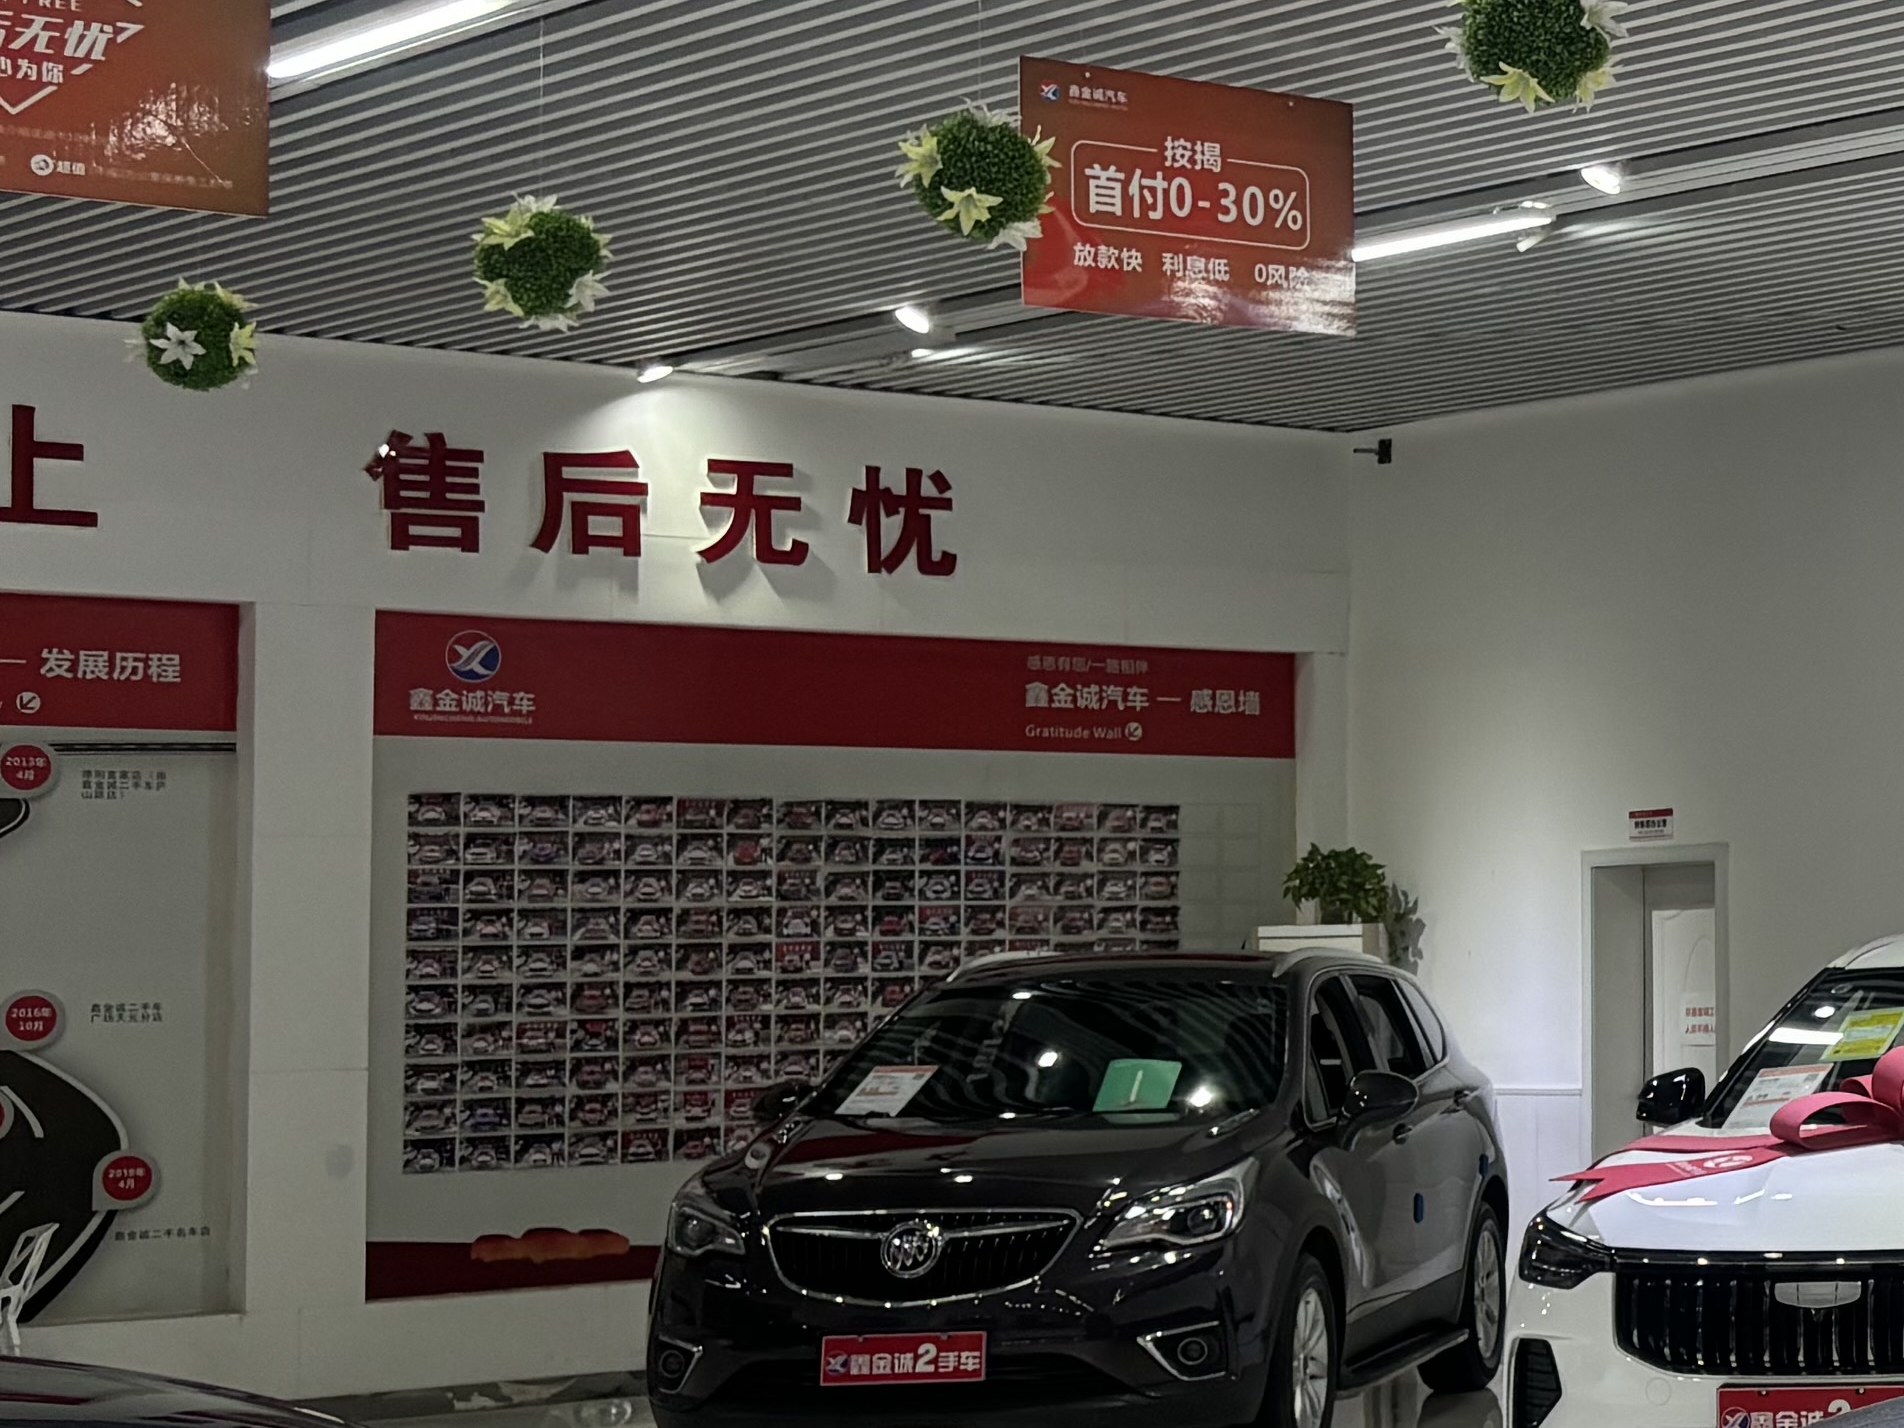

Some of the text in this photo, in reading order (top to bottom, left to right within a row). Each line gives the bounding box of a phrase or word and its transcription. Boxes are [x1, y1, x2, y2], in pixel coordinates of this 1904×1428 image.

[0, 10, 114, 61] 无忧
[1164, 136, 1222, 172] 按揭
[1084, 164, 1303, 231] 首付0-30%
[1073, 242, 1143, 273] 放款快
[1161, 252, 1230, 282] 利息低
[364, 430, 959, 578] 售后无忧
[40, 647, 182, 684] 发展历程
[409, 687, 536, 714] 鑫金诚汽车
[1025, 681, 1150, 712] 鑫金诚汽车
[1190, 689, 1260, 715] 感恩墙
[1025, 724, 1122, 740] Gratitude Wall
[850, 1342, 981, 1376] 鑫金诚2手车
